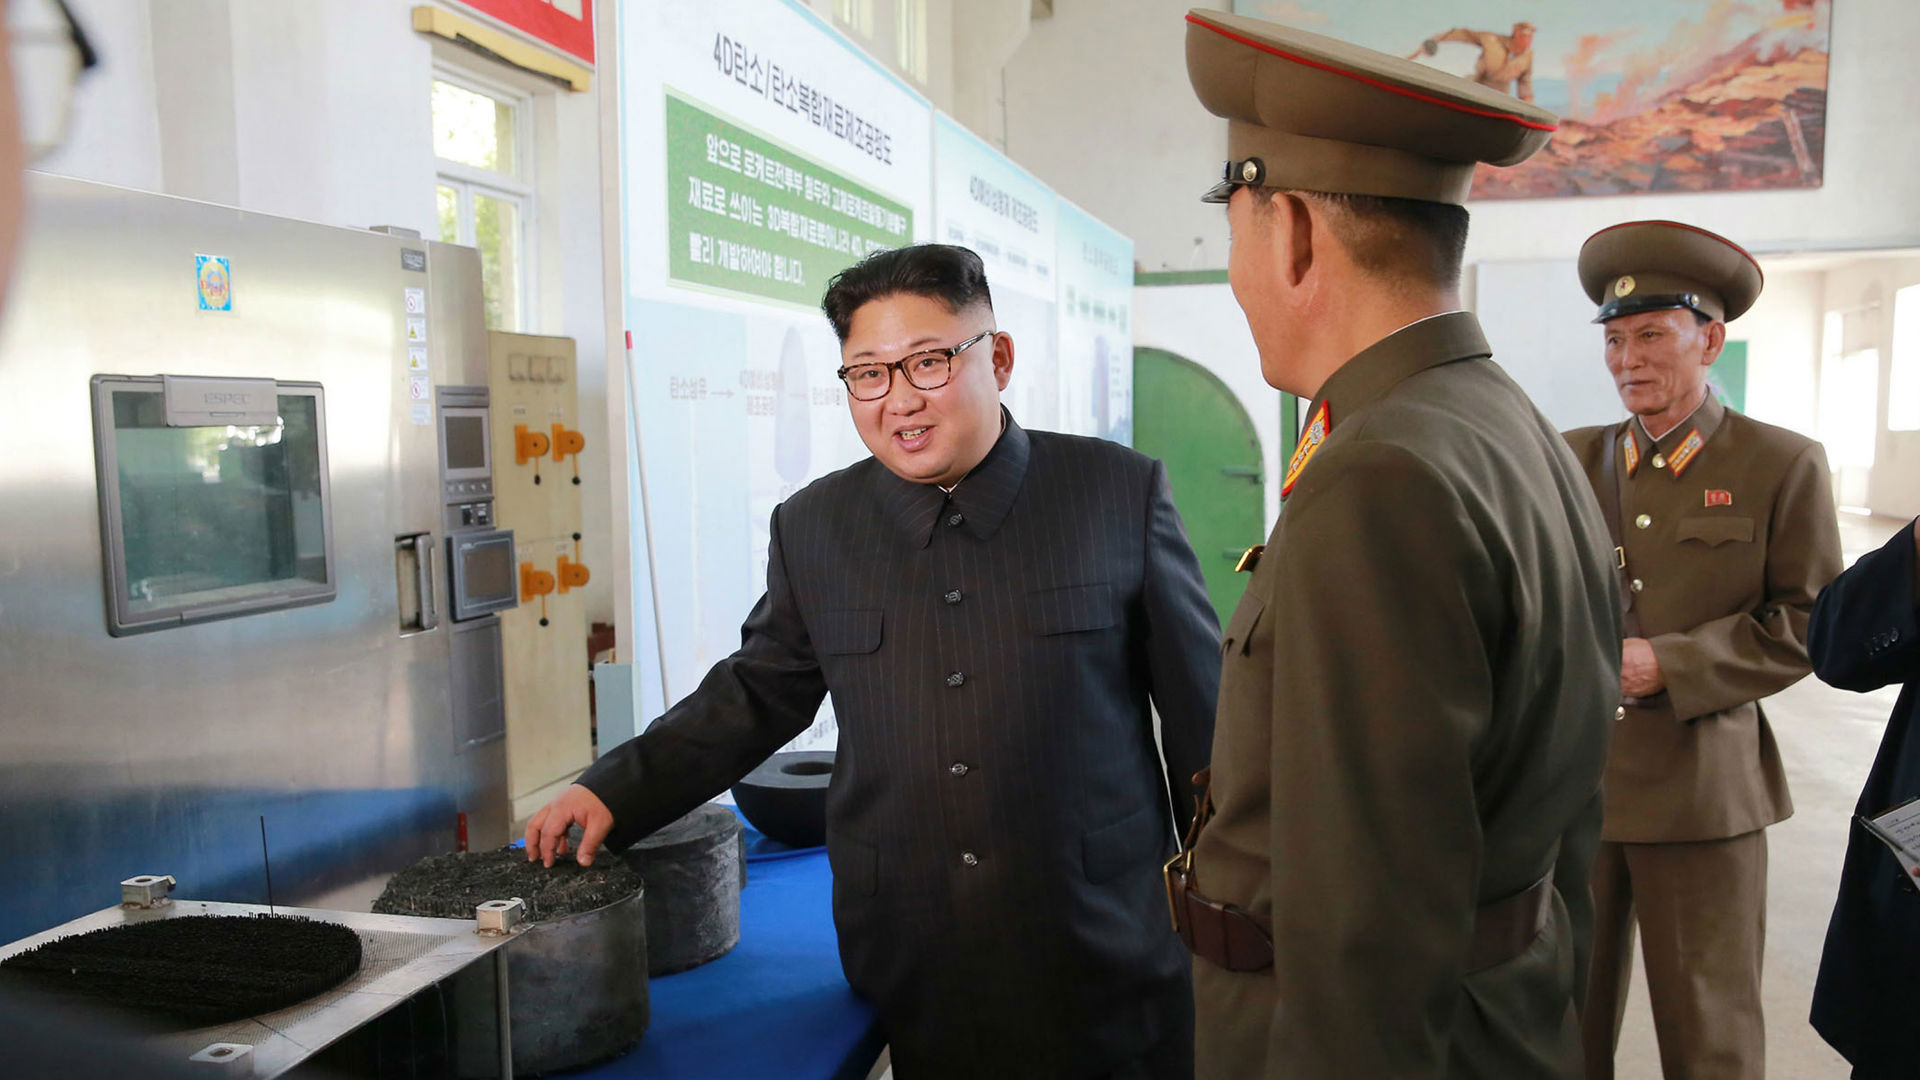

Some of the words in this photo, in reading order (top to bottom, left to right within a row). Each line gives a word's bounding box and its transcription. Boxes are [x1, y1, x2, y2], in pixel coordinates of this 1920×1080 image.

[706, 133, 742, 174] 앞으로
[688, 176, 727, 217] 재료로
[729, 190, 764, 229] 쓰이는
[689, 231, 715, 266] 빨리
[717, 238, 772, 280] 개발하여야
